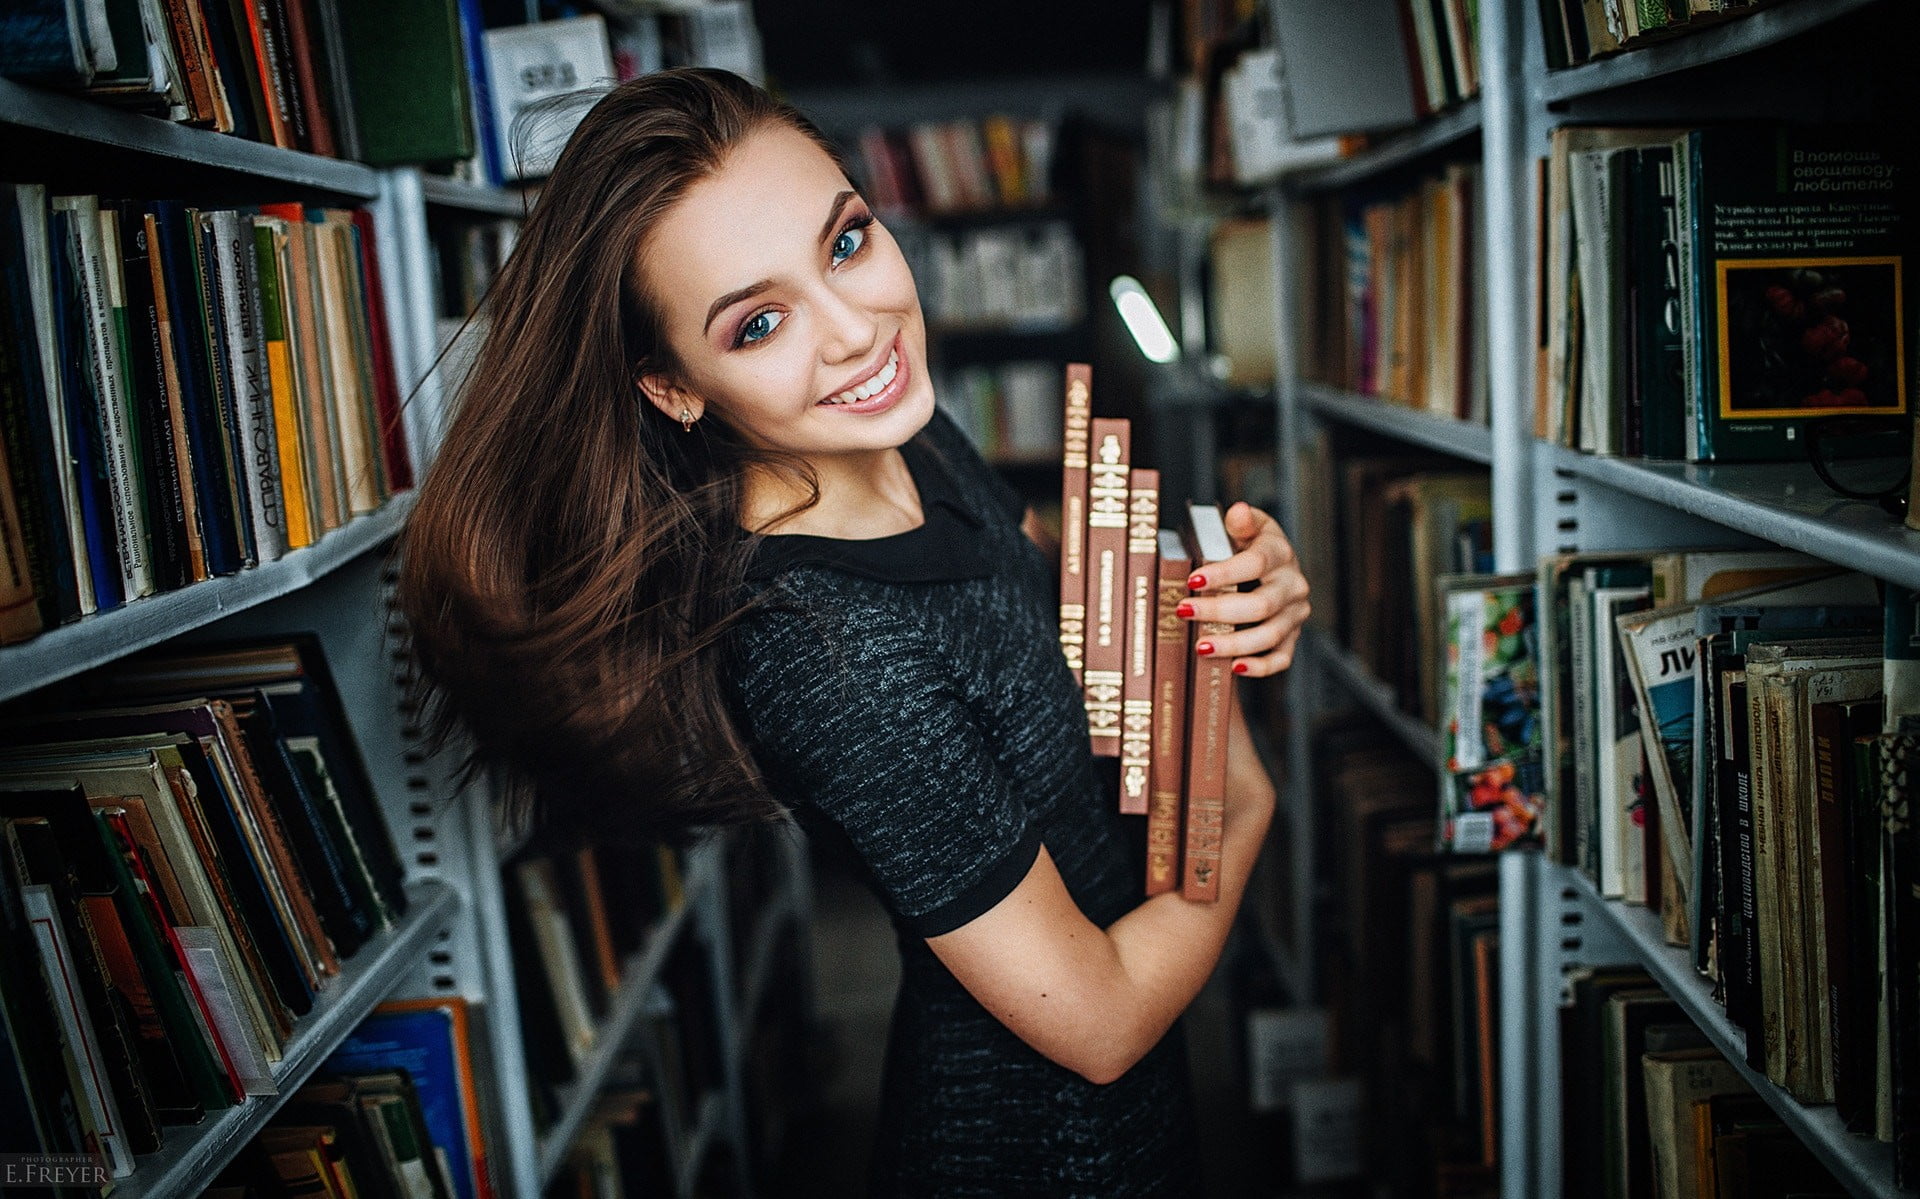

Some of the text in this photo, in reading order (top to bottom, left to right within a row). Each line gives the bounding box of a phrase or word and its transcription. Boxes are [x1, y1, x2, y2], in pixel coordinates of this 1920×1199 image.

[1793, 178, 1894, 192] любителю
[1808, 151, 1881, 162] помощь
[90, 254, 105, 310] ветеринарии
[197, 242, 214, 326] ВЕТЕРИНАРИИ
[99, 321, 113, 370] препаратов
[93, 361, 110, 431] ЭКСПЕРТИЗА
[107, 373, 123, 438] лекарственных
[148, 303, 184, 522] ВЕТЕРИНАРНАЯ ТОКСИКОЛОГИЯ
[211, 344, 228, 429] АНТИБИОТИКИ
[231, 238, 278, 528] СПРАВОЧНИК ВЕТЕРИНАРНОГО
[117, 442, 133, 506] использование
[126, 509, 142, 568] Рациональное
[1753, 695, 1762, 760] ЦВЕТОВОДА
[1738, 770, 1748, 812] ШКОЛЕ
[1741, 817, 1748, 827] В
[1758, 804, 1766, 854] УЧЕБНАЯ
[1740, 832, 1753, 919] ЦВЕТОВОДСТВО
